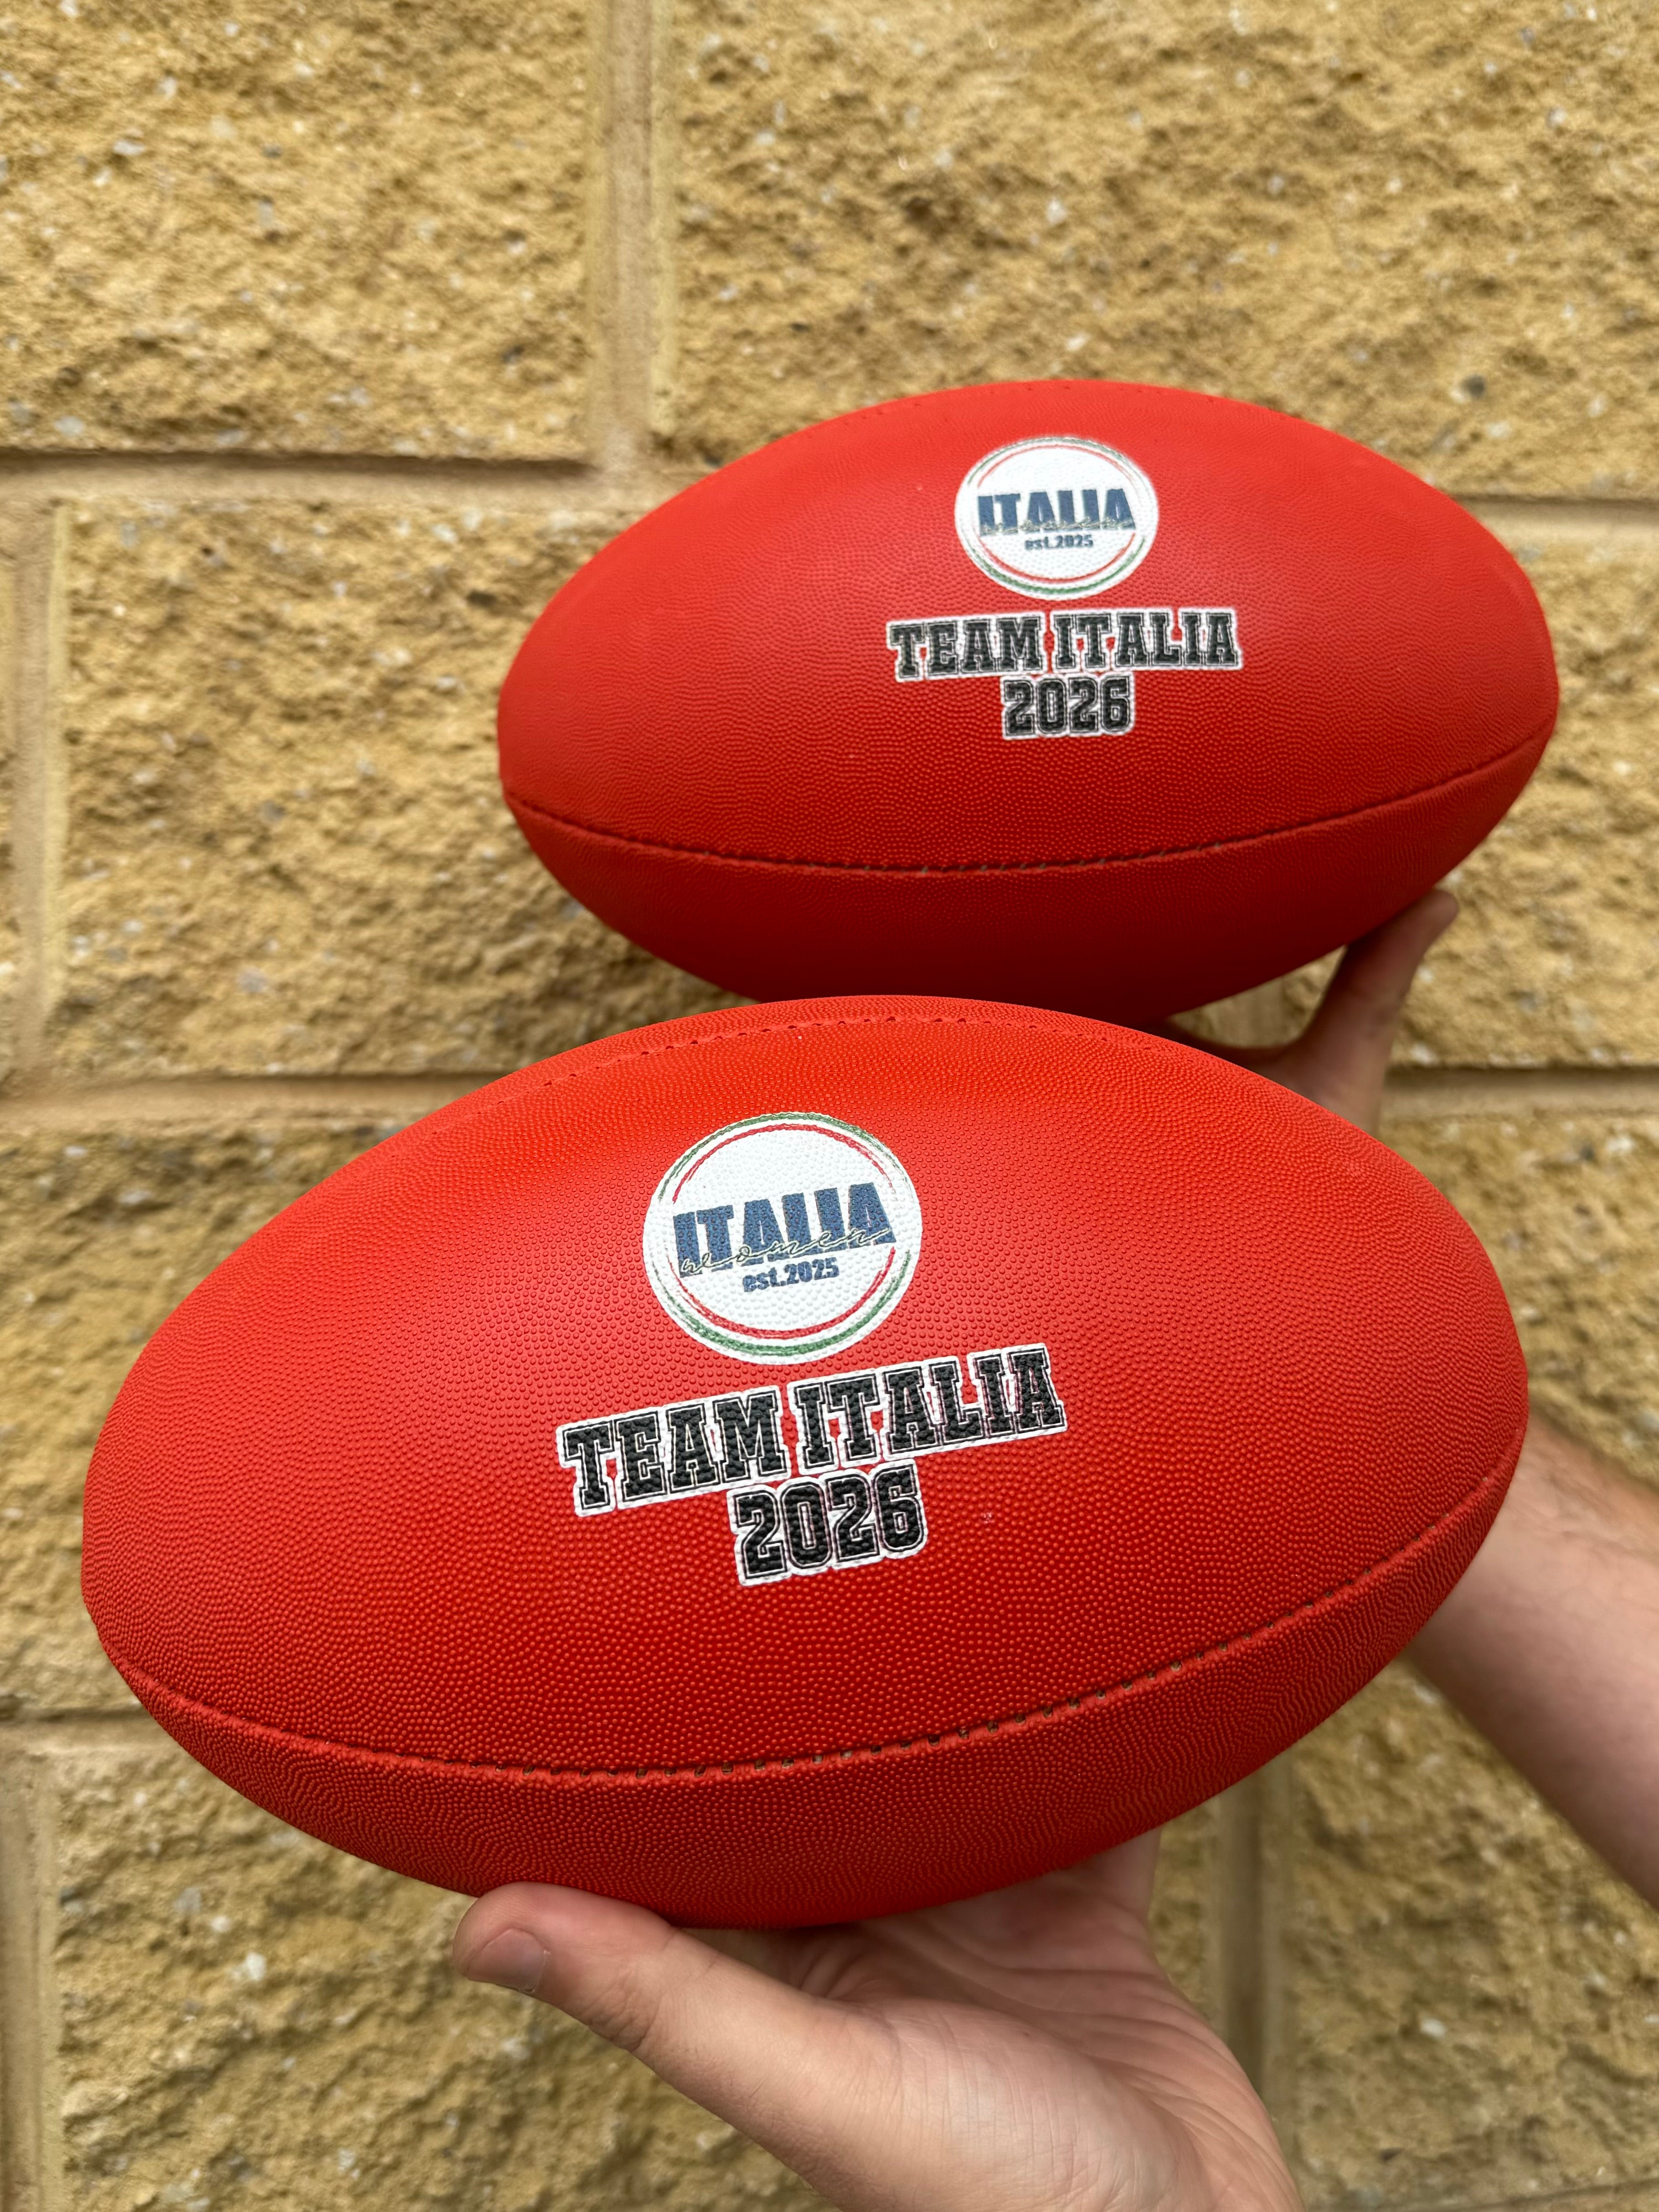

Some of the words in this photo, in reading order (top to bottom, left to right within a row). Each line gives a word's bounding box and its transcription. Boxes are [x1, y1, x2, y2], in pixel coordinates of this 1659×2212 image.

[977, 488, 1136, 536] ITALIA
[1025, 534, 1094, 550] est.2025
[889, 615, 1045, 681] TEAM
[1051, 611, 1241, 671] ITALIA
[1003, 674, 1133, 738] 2026
[673, 1182, 896, 1277] ITALIA
[742, 1256, 840, 1293] est.2025
[560, 1388, 788, 1513] TEAM
[791, 1345, 1065, 1470] ITALIA
[730, 1462, 925, 1583] 2026
